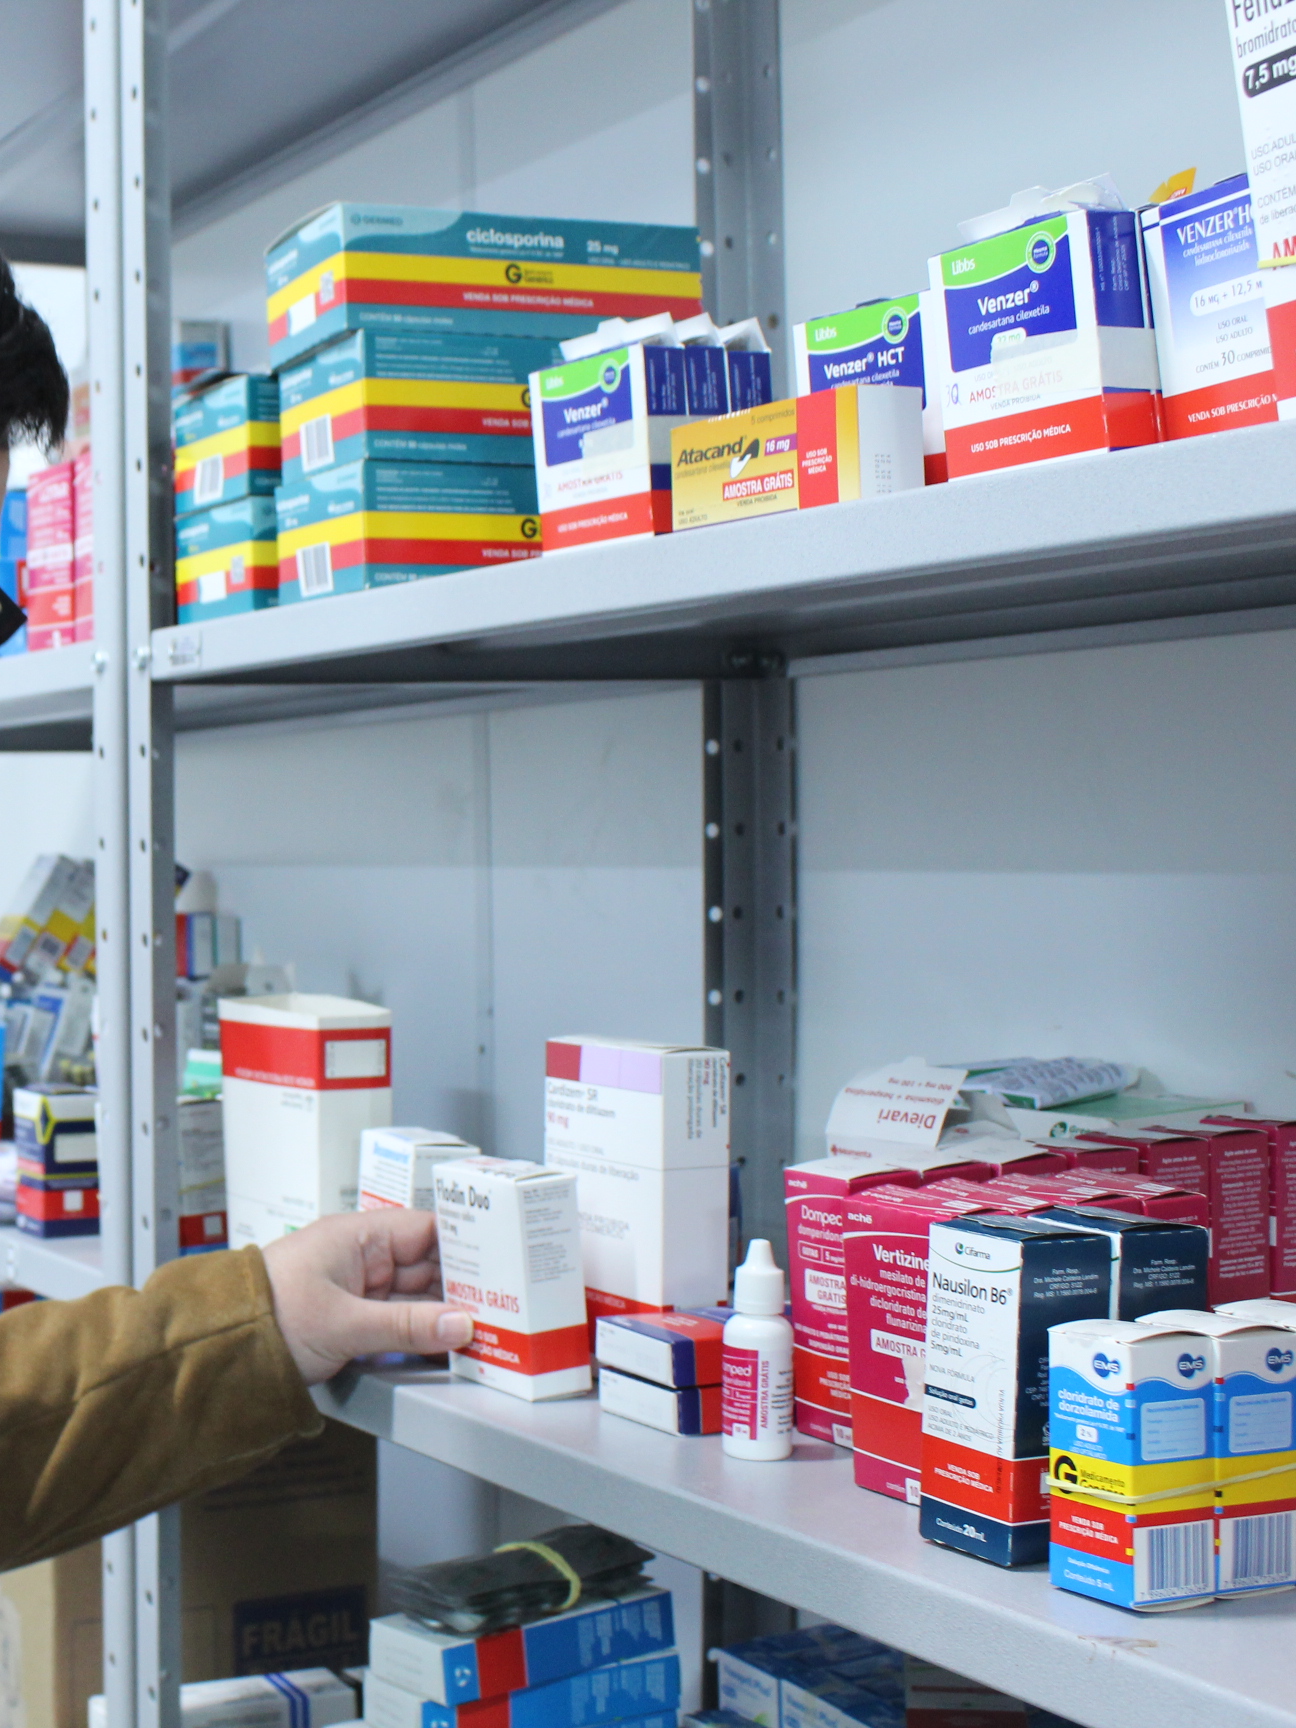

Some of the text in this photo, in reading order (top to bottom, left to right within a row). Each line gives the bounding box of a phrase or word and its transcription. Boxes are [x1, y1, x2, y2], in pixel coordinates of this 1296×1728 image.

[1245, 68, 1269, 90] 7,5
[466, 228, 619, 254] ciclosporina 25 mg
[506, 263, 522, 283] G
[952, 258, 975, 275] Libbs
[1195, 294, 1205, 309] 16
[1232, 280, 1252, 299] 12,5
[969, 304, 1050, 335] candesartana cilexetila
[1217, 315, 1248, 330] USO ORAL
[815, 327, 836, 342] Libbs
[1216, 327, 1253, 344] USO ADULTO
[878, 347, 905, 368] HCT
[1195, 349, 1236, 373] CONTÉM 30
[872, 369, 900, 382] cilexetila
[969, 380, 1019, 403] AMOSTRA
[1022, 370, 1063, 391] GRÁTIS
[757, 408, 795, 424] comprimidos
[1188, 394, 1270, 423] VENDA SOB PRESCRIÇÃO
[483, 418, 510, 427] VENDA
[765, 441, 775, 452] 16
[777, 438, 790, 451] mg
[971, 423, 1071, 453] USO SOB PRESCRIÇÃO MÉDICA
[808, 465, 826, 474] MÉDICA
[724, 472, 793, 499] AMOSTRA GRÁTIS
[521, 518, 537, 539] G
[877, 1108, 936, 1129] Dievari
[468, 1185, 490, 1210] Duo
[848, 1212, 872, 1224] aché
[872, 1243, 930, 1271] Vertizine
[964, 1246, 991, 1260] Cifarma
[809, 1274, 846, 1290] AMOSTRA
[880, 1269, 926, 1288] mesilato de
[932, 1272, 987, 1301] Nausilon
[486, 1288, 519, 1314] GRÁTIS
[870, 1295, 927, 1320] dicloridrato de
[932, 1294, 985, 1314] dimenidrinato
[932, 1317, 967, 1334] cloridrato
[875, 1337, 917, 1357] AMOSTRA
[931, 1329, 980, 1350] de piridoxina
[1094, 1360, 1120, 1372] EMS
[1179, 1360, 1204, 1370] EMS
[1268, 1354, 1292, 1365] EMS
[760, 1361, 769, 1428] AMOSTRA GRÁTIS
[1058, 1388, 1120, 1411] cloridrato de
[1059, 1400, 1120, 1423] dorzolamida
[947, 1463, 980, 1480] VENDA SOB
[1054, 1455, 1077, 1494] G
[1080, 1470, 1125, 1488] Medicamento
[1071, 1515, 1105, 1531] VENDA SOB
[1095, 1531, 1119, 1544] MÉDICA
[242, 1609, 361, 1656] FRÁGIL
